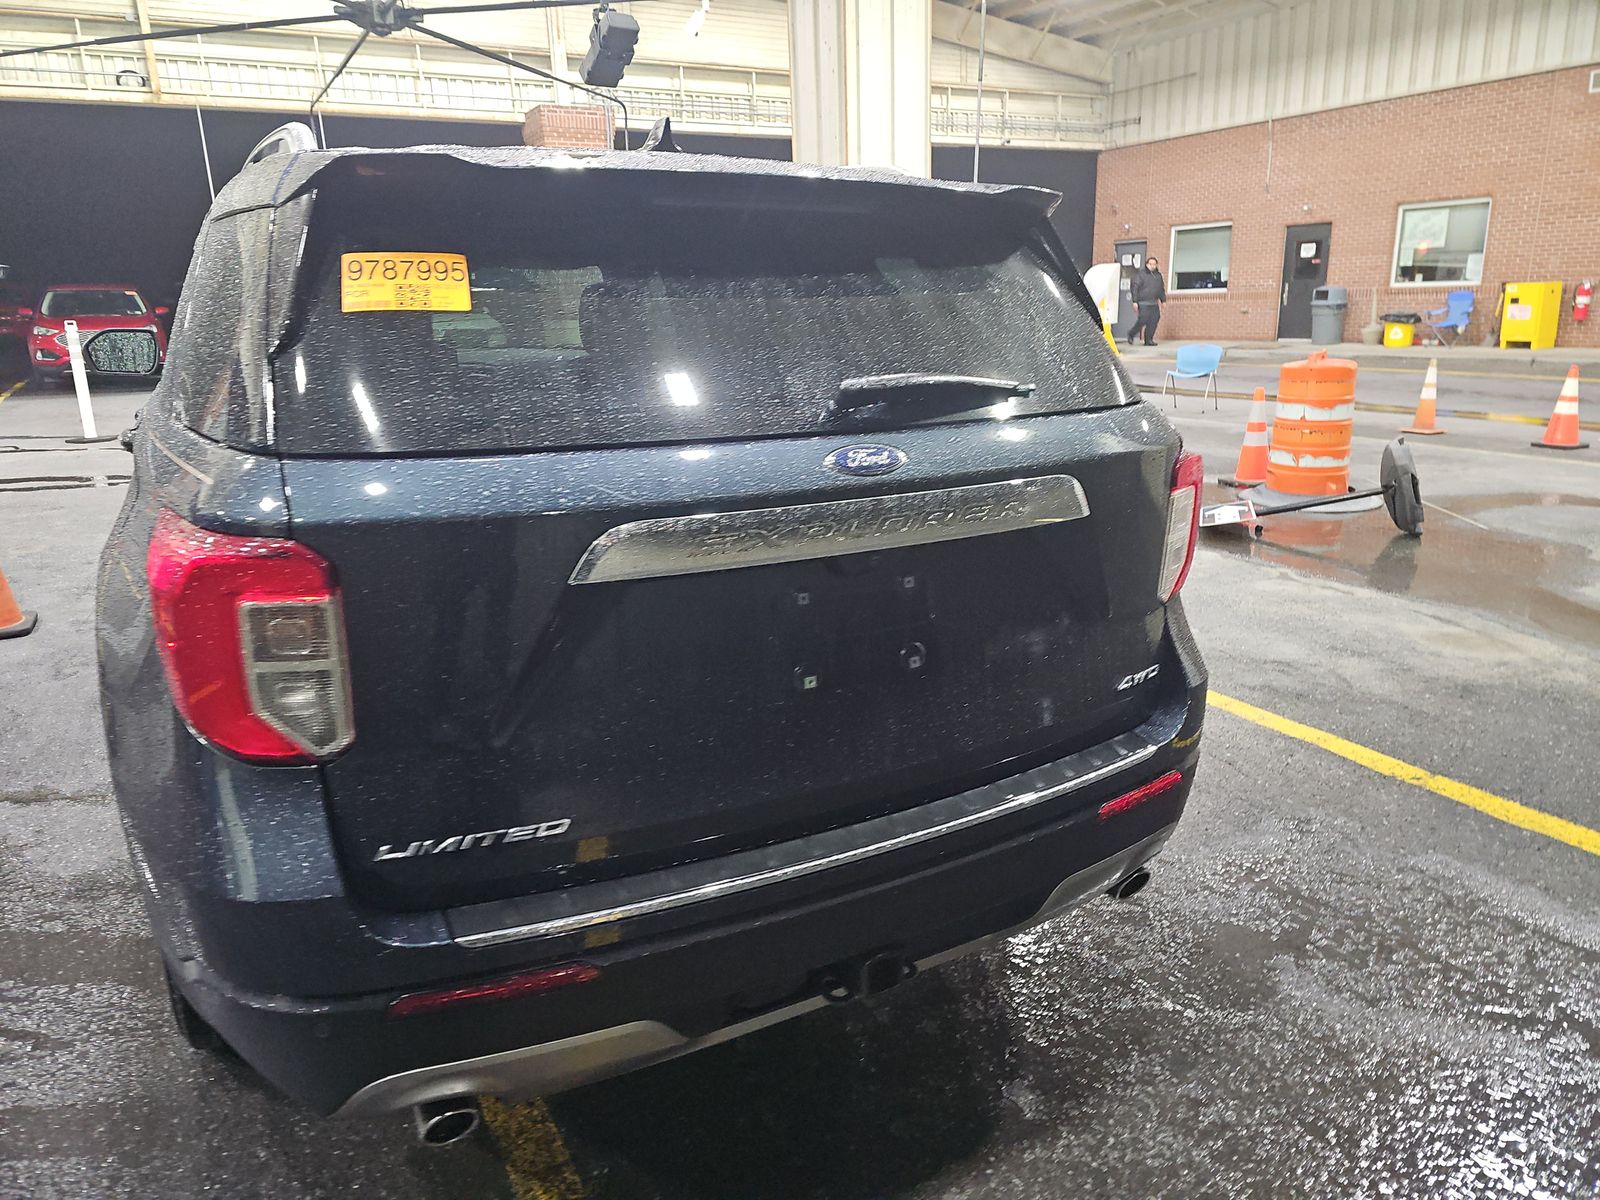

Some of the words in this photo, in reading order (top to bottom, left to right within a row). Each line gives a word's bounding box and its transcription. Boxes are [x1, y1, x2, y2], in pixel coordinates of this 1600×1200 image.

[348, 259, 465, 281] 9787995
[847, 448, 891, 468] Ford
[372, 818, 571, 861] LIMITED
